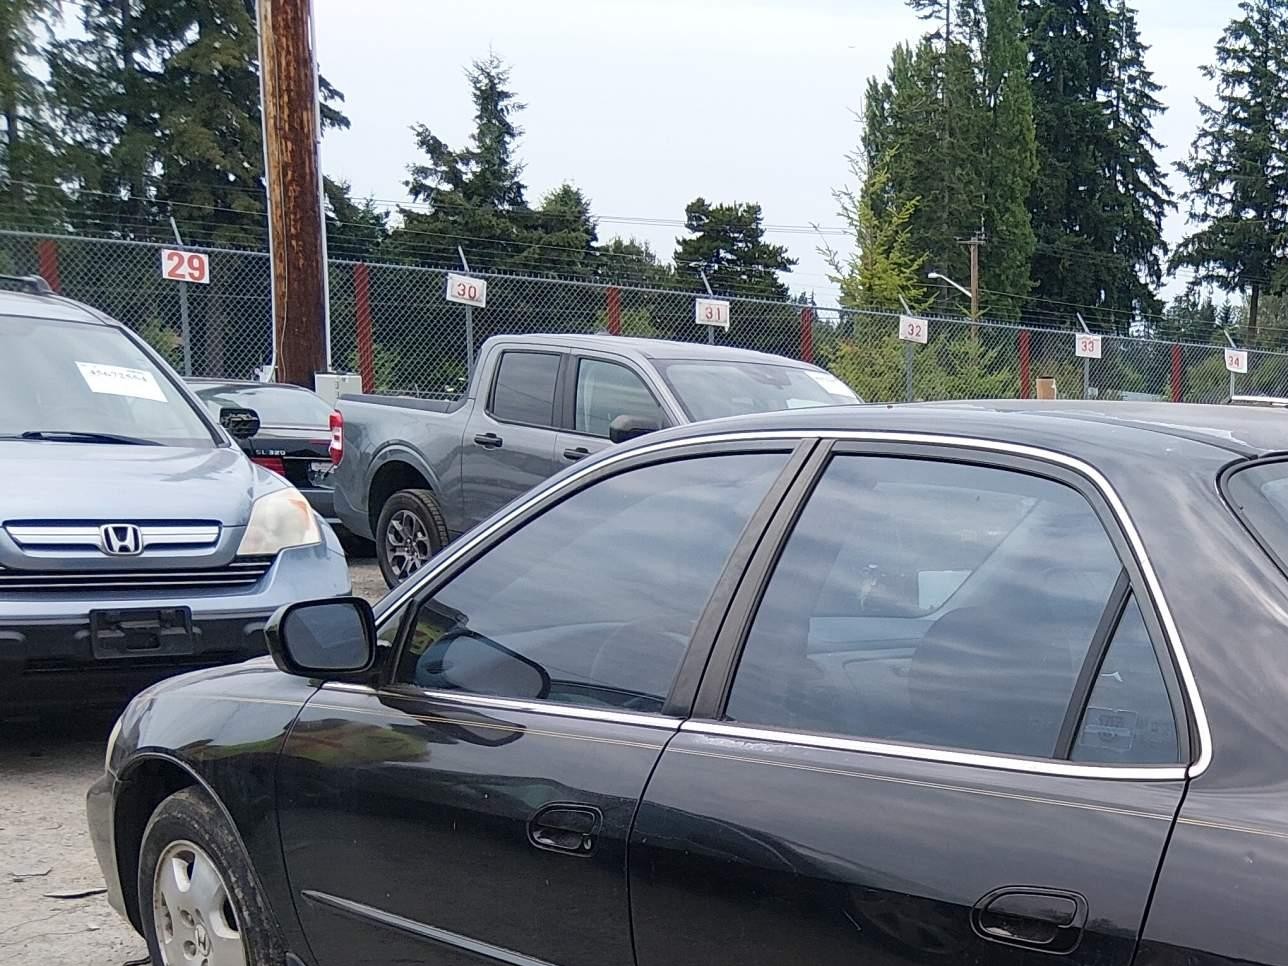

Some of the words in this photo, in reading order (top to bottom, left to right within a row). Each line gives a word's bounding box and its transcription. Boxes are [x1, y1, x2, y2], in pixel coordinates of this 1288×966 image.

[167, 252, 205, 281] 29
[457, 282, 477, 300] 30
[705, 306, 721, 321] 31
[907, 323, 922, 338] 32
[1081, 340, 1095, 353] 33
[1228, 355, 1240, 368] 34
